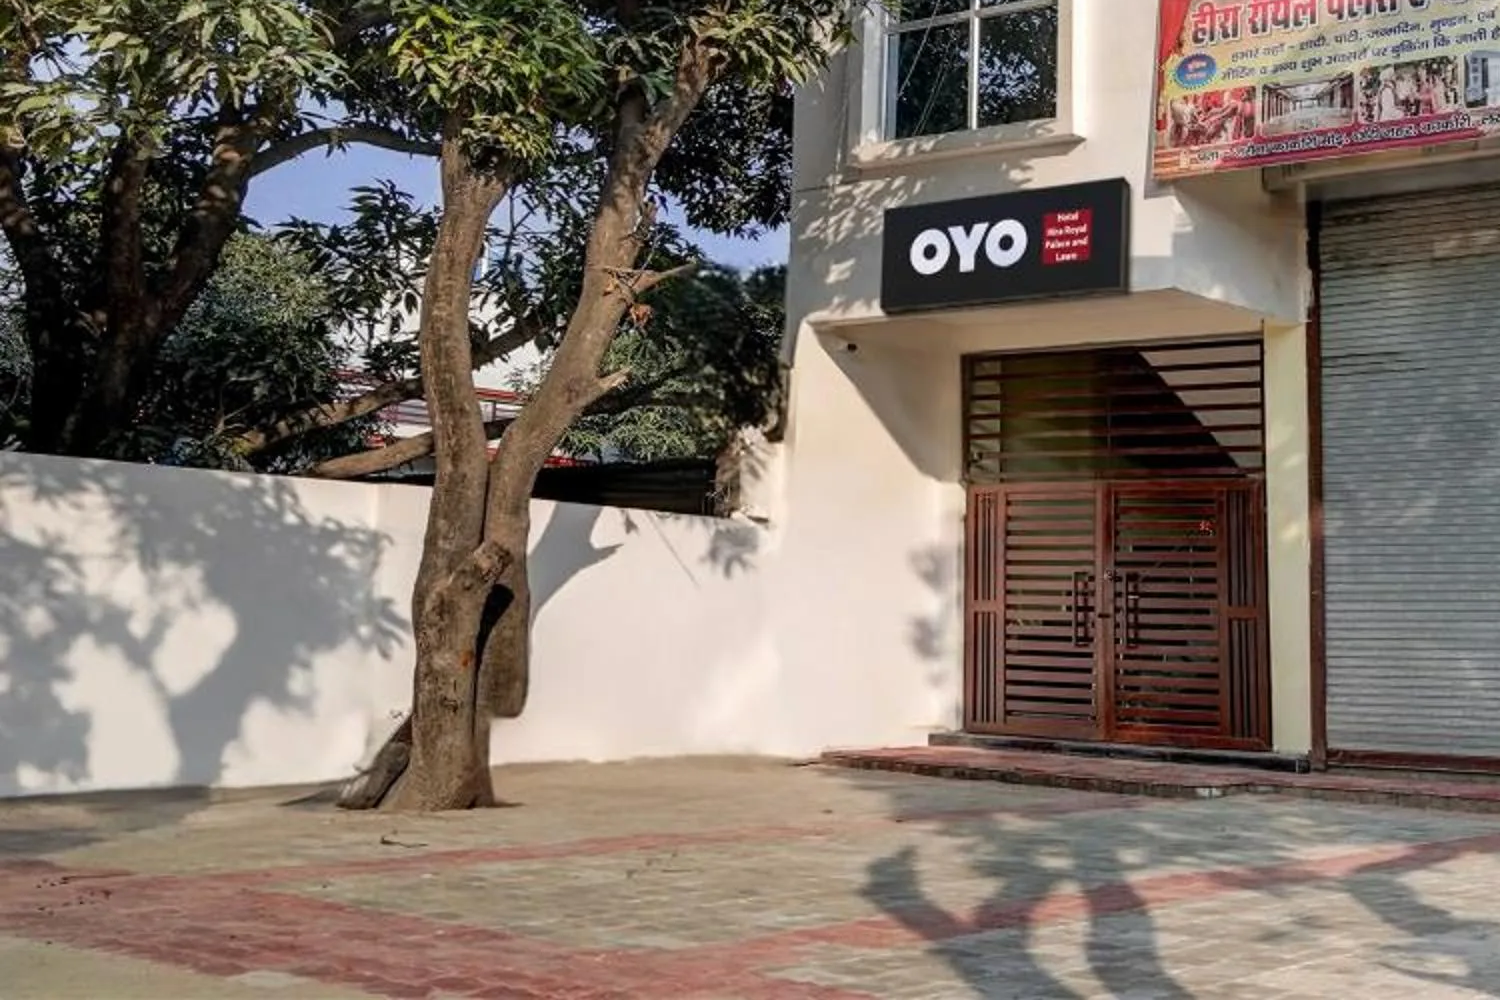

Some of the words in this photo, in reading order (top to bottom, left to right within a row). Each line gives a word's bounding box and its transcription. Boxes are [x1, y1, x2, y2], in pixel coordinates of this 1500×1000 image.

[1192, 1, 1241, 44] हीरा
[1064, 223, 1087, 236] Royal
[909, 218, 1028, 276] OYO
[1045, 239, 1070, 249] Palace
[1072, 236, 1088, 247] and
[1055, 252, 1077, 261] Lawn
